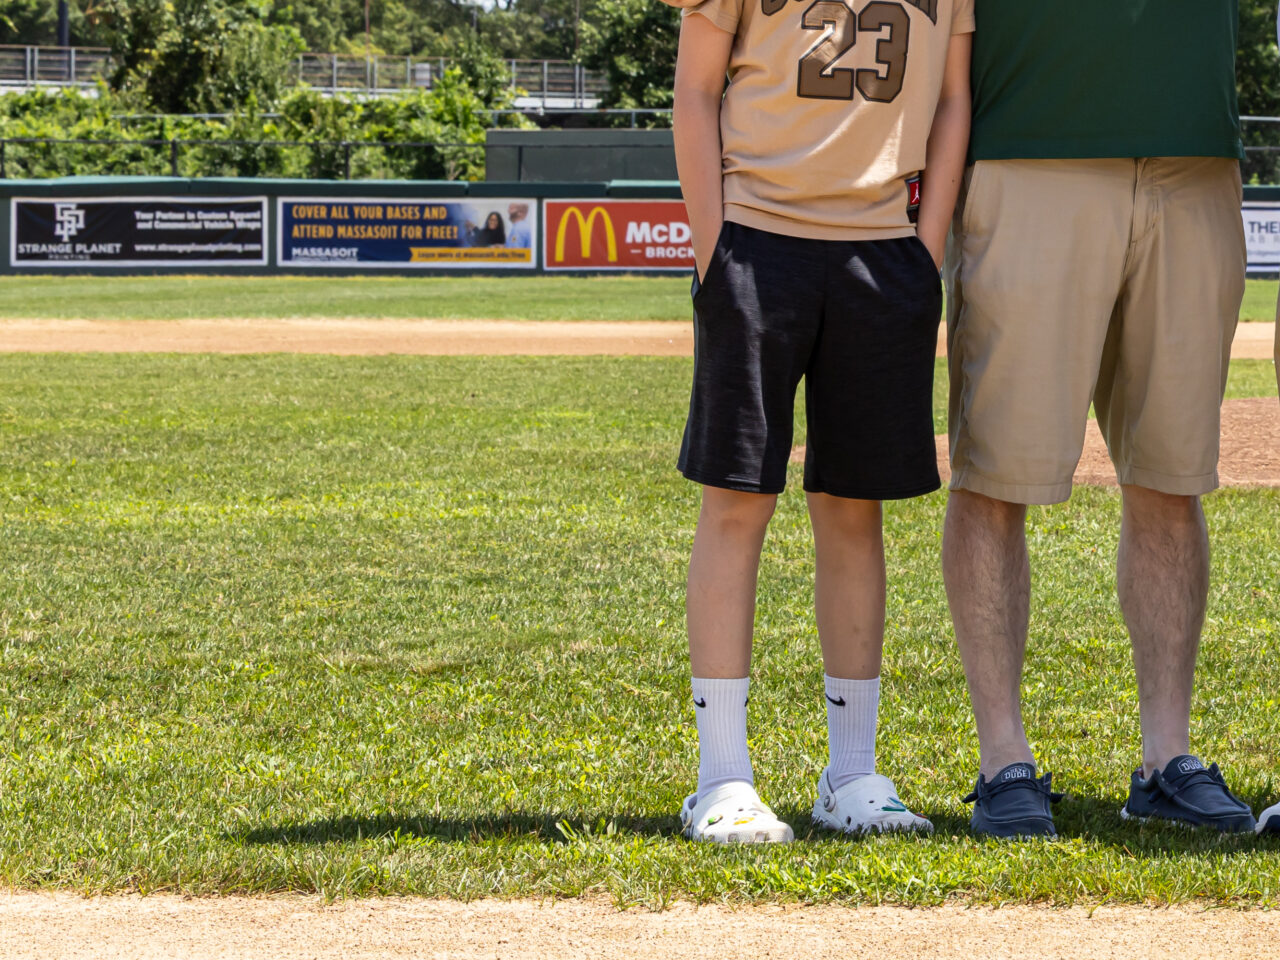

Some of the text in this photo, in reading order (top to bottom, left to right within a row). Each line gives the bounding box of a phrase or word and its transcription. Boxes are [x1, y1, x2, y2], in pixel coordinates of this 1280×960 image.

[797, 0, 911, 103] 23
[292, 205, 448, 220] COVER ALL YOUR BASES AND
[291, 224, 459, 239] ATTEND MASSASOIT FOR FREE!
[18, 243, 122, 254] STRANGE PLANET
[291, 246, 359, 258] MASSASOIT
[1003, 770, 1028, 780] DUDE
